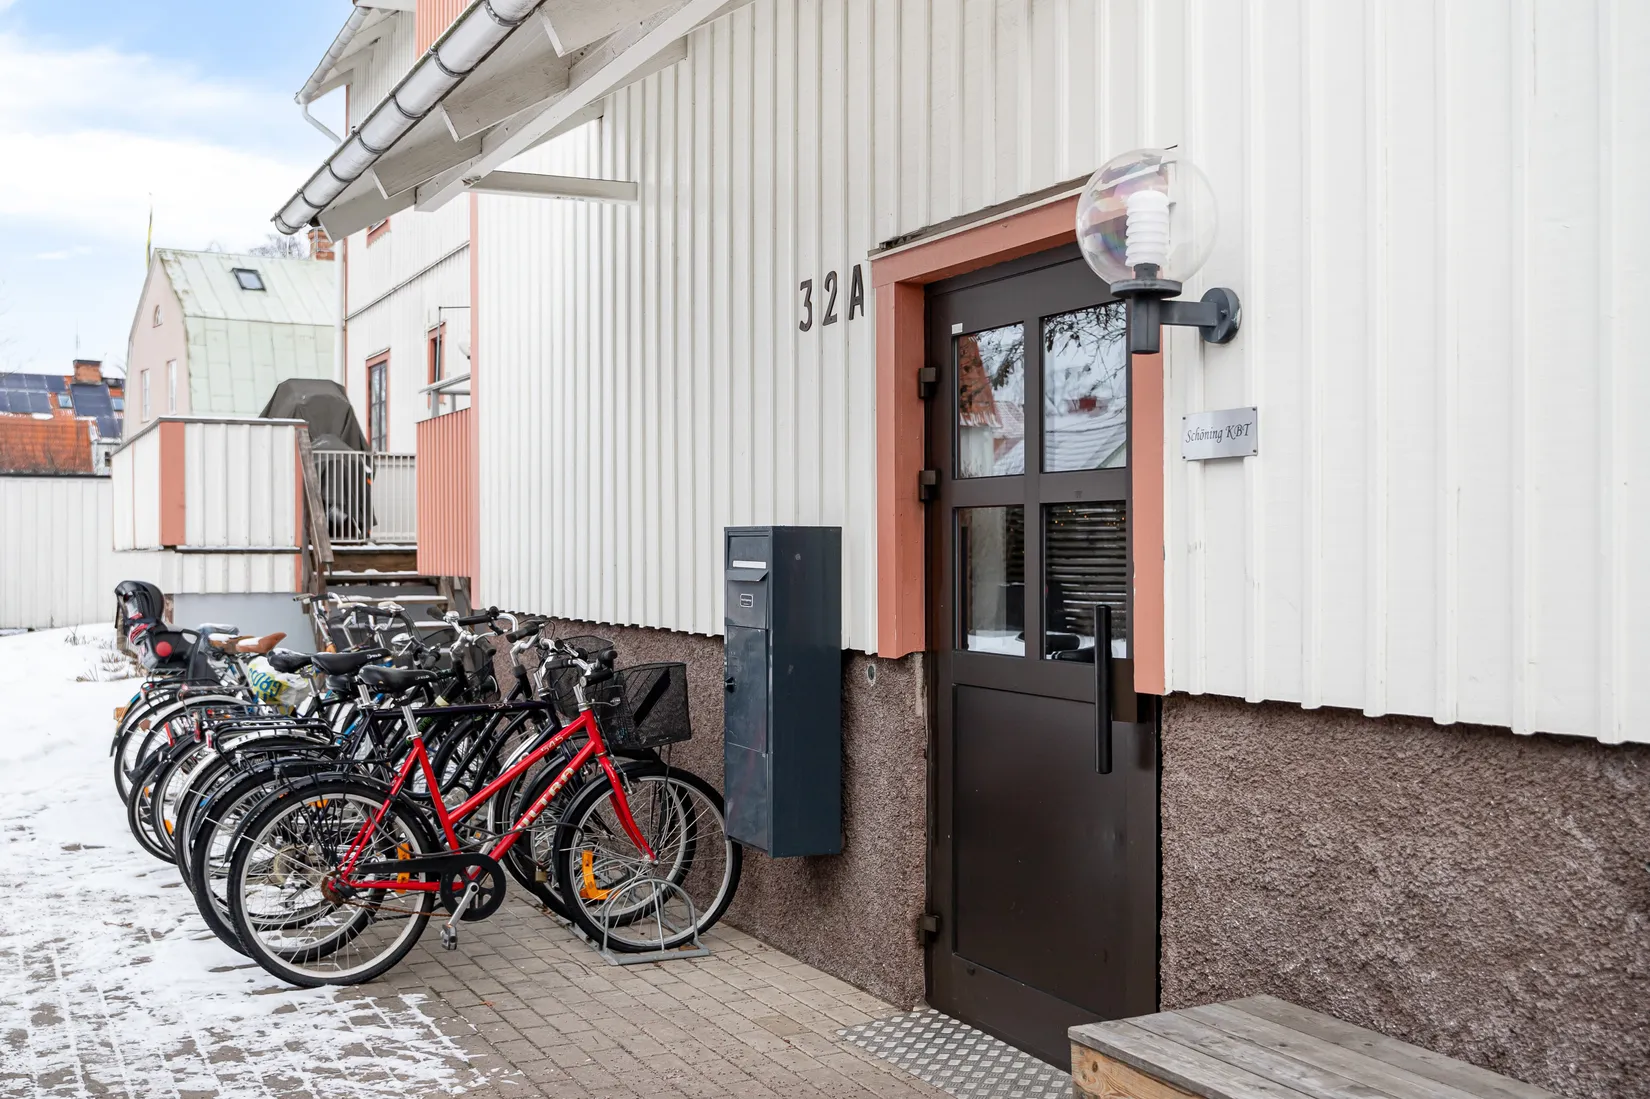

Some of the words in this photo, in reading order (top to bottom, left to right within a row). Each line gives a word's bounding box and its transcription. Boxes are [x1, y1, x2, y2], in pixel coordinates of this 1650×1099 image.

[799, 263, 865, 333] 32A
[1185, 426, 1223, 444] Schöning
[1225, 421, 1253, 441] KBT
[540, 734, 564, 753] 545
[514, 767, 576, 833] ULTRA
